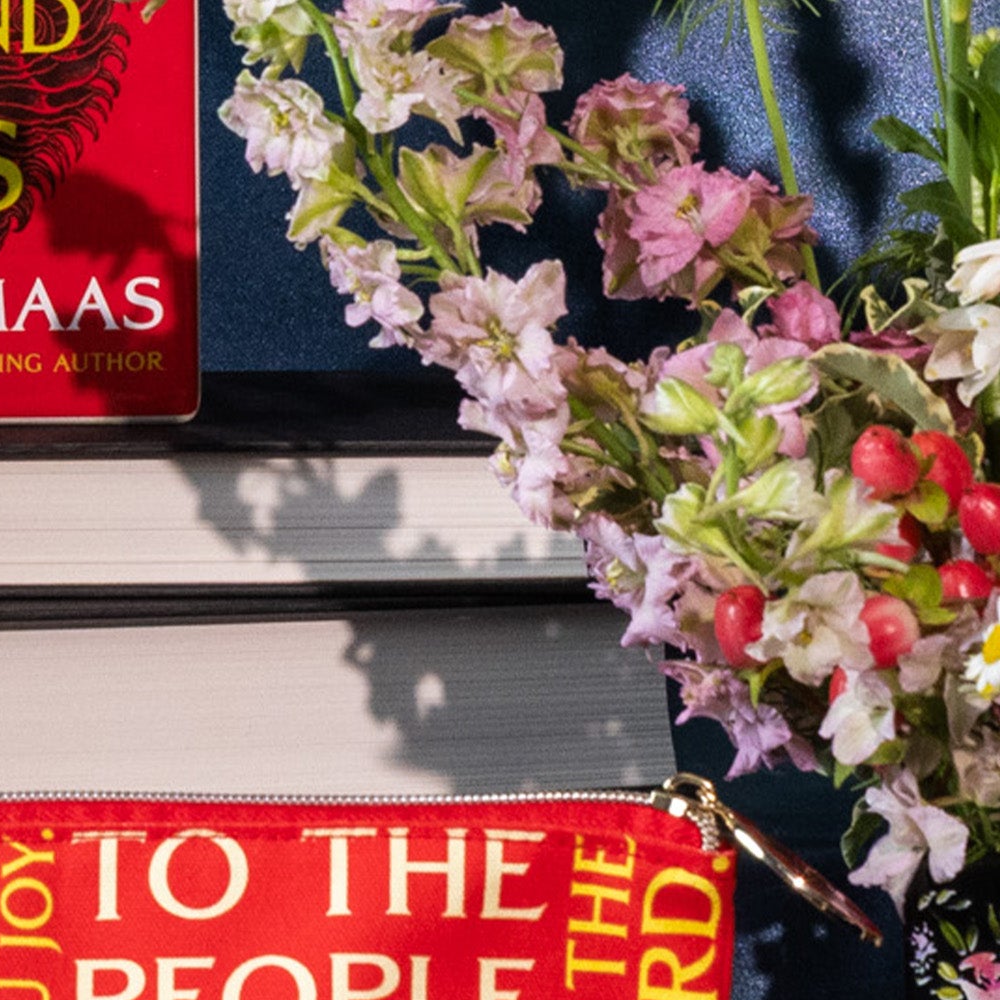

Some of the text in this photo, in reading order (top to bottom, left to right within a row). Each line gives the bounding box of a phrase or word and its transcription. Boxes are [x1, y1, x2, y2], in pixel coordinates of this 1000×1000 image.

[53, 351, 165, 372] AUTHOR
[71, 827, 549, 921] TO THE
[565, 833, 638, 991] THE
